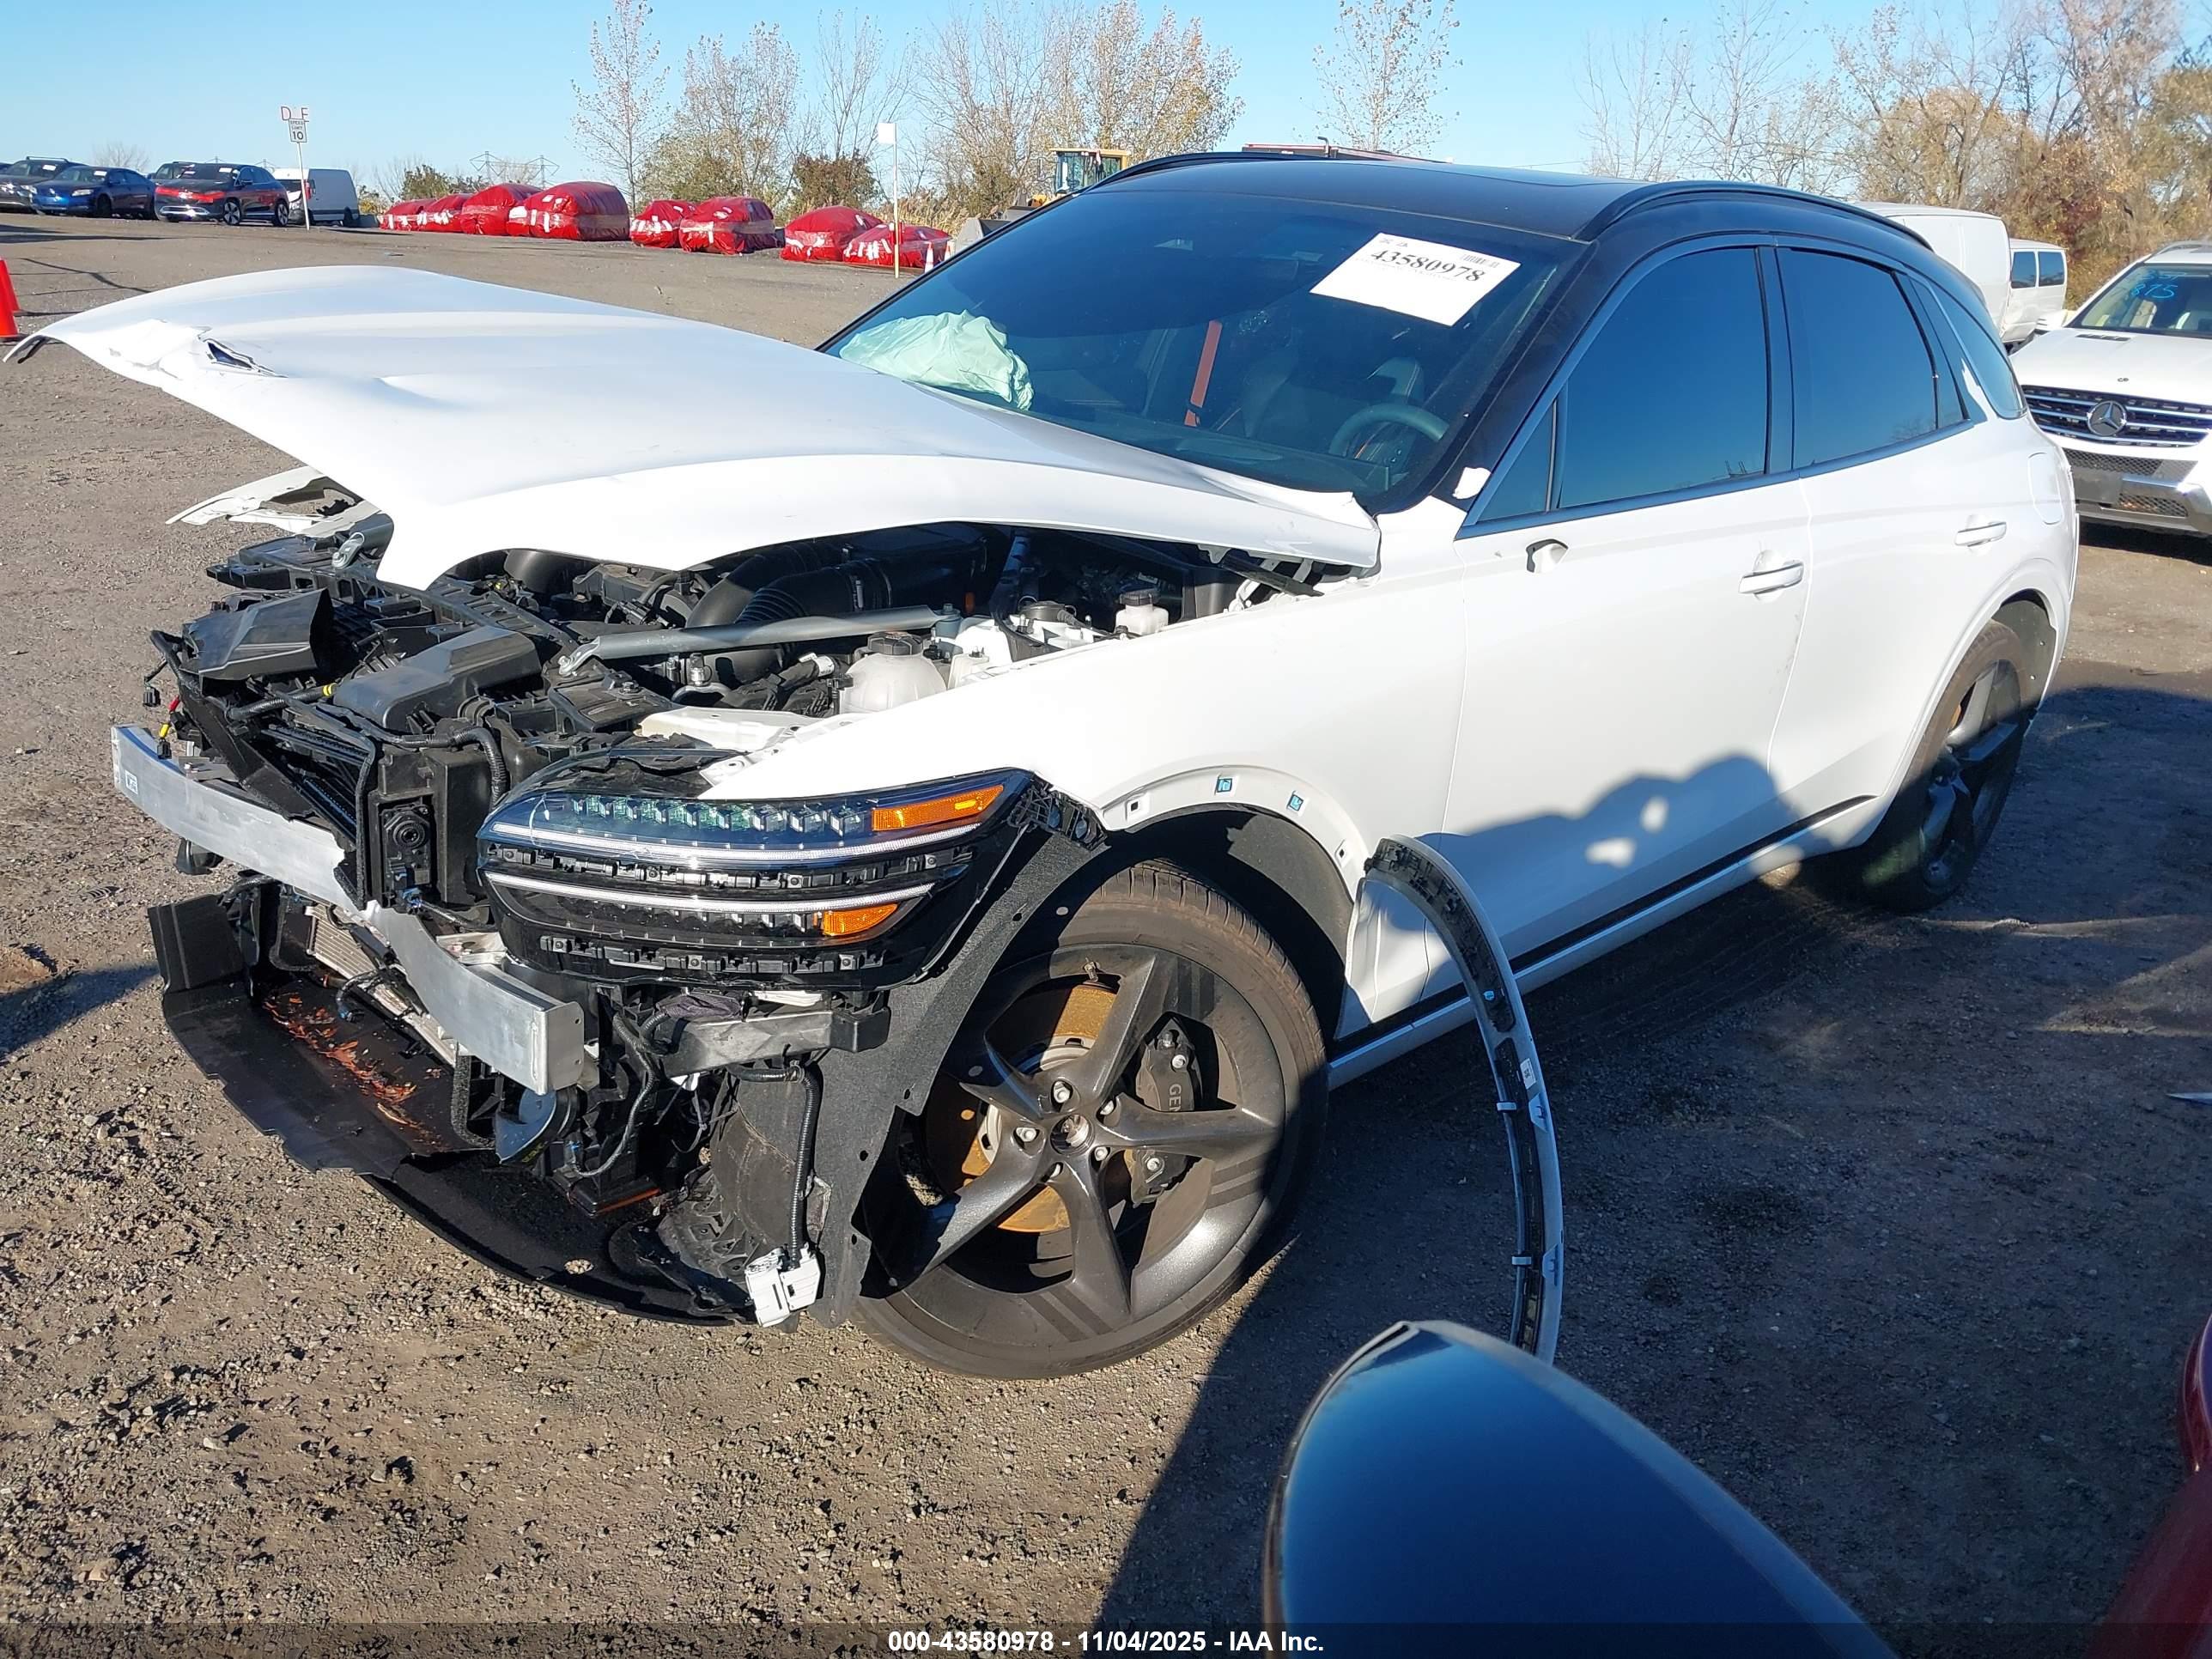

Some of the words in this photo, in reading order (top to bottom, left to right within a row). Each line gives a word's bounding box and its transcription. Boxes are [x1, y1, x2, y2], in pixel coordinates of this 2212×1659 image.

[281, 106, 292, 121] D
[292, 131, 304, 140] 10
[1370, 250, 1486, 282] 43580978
